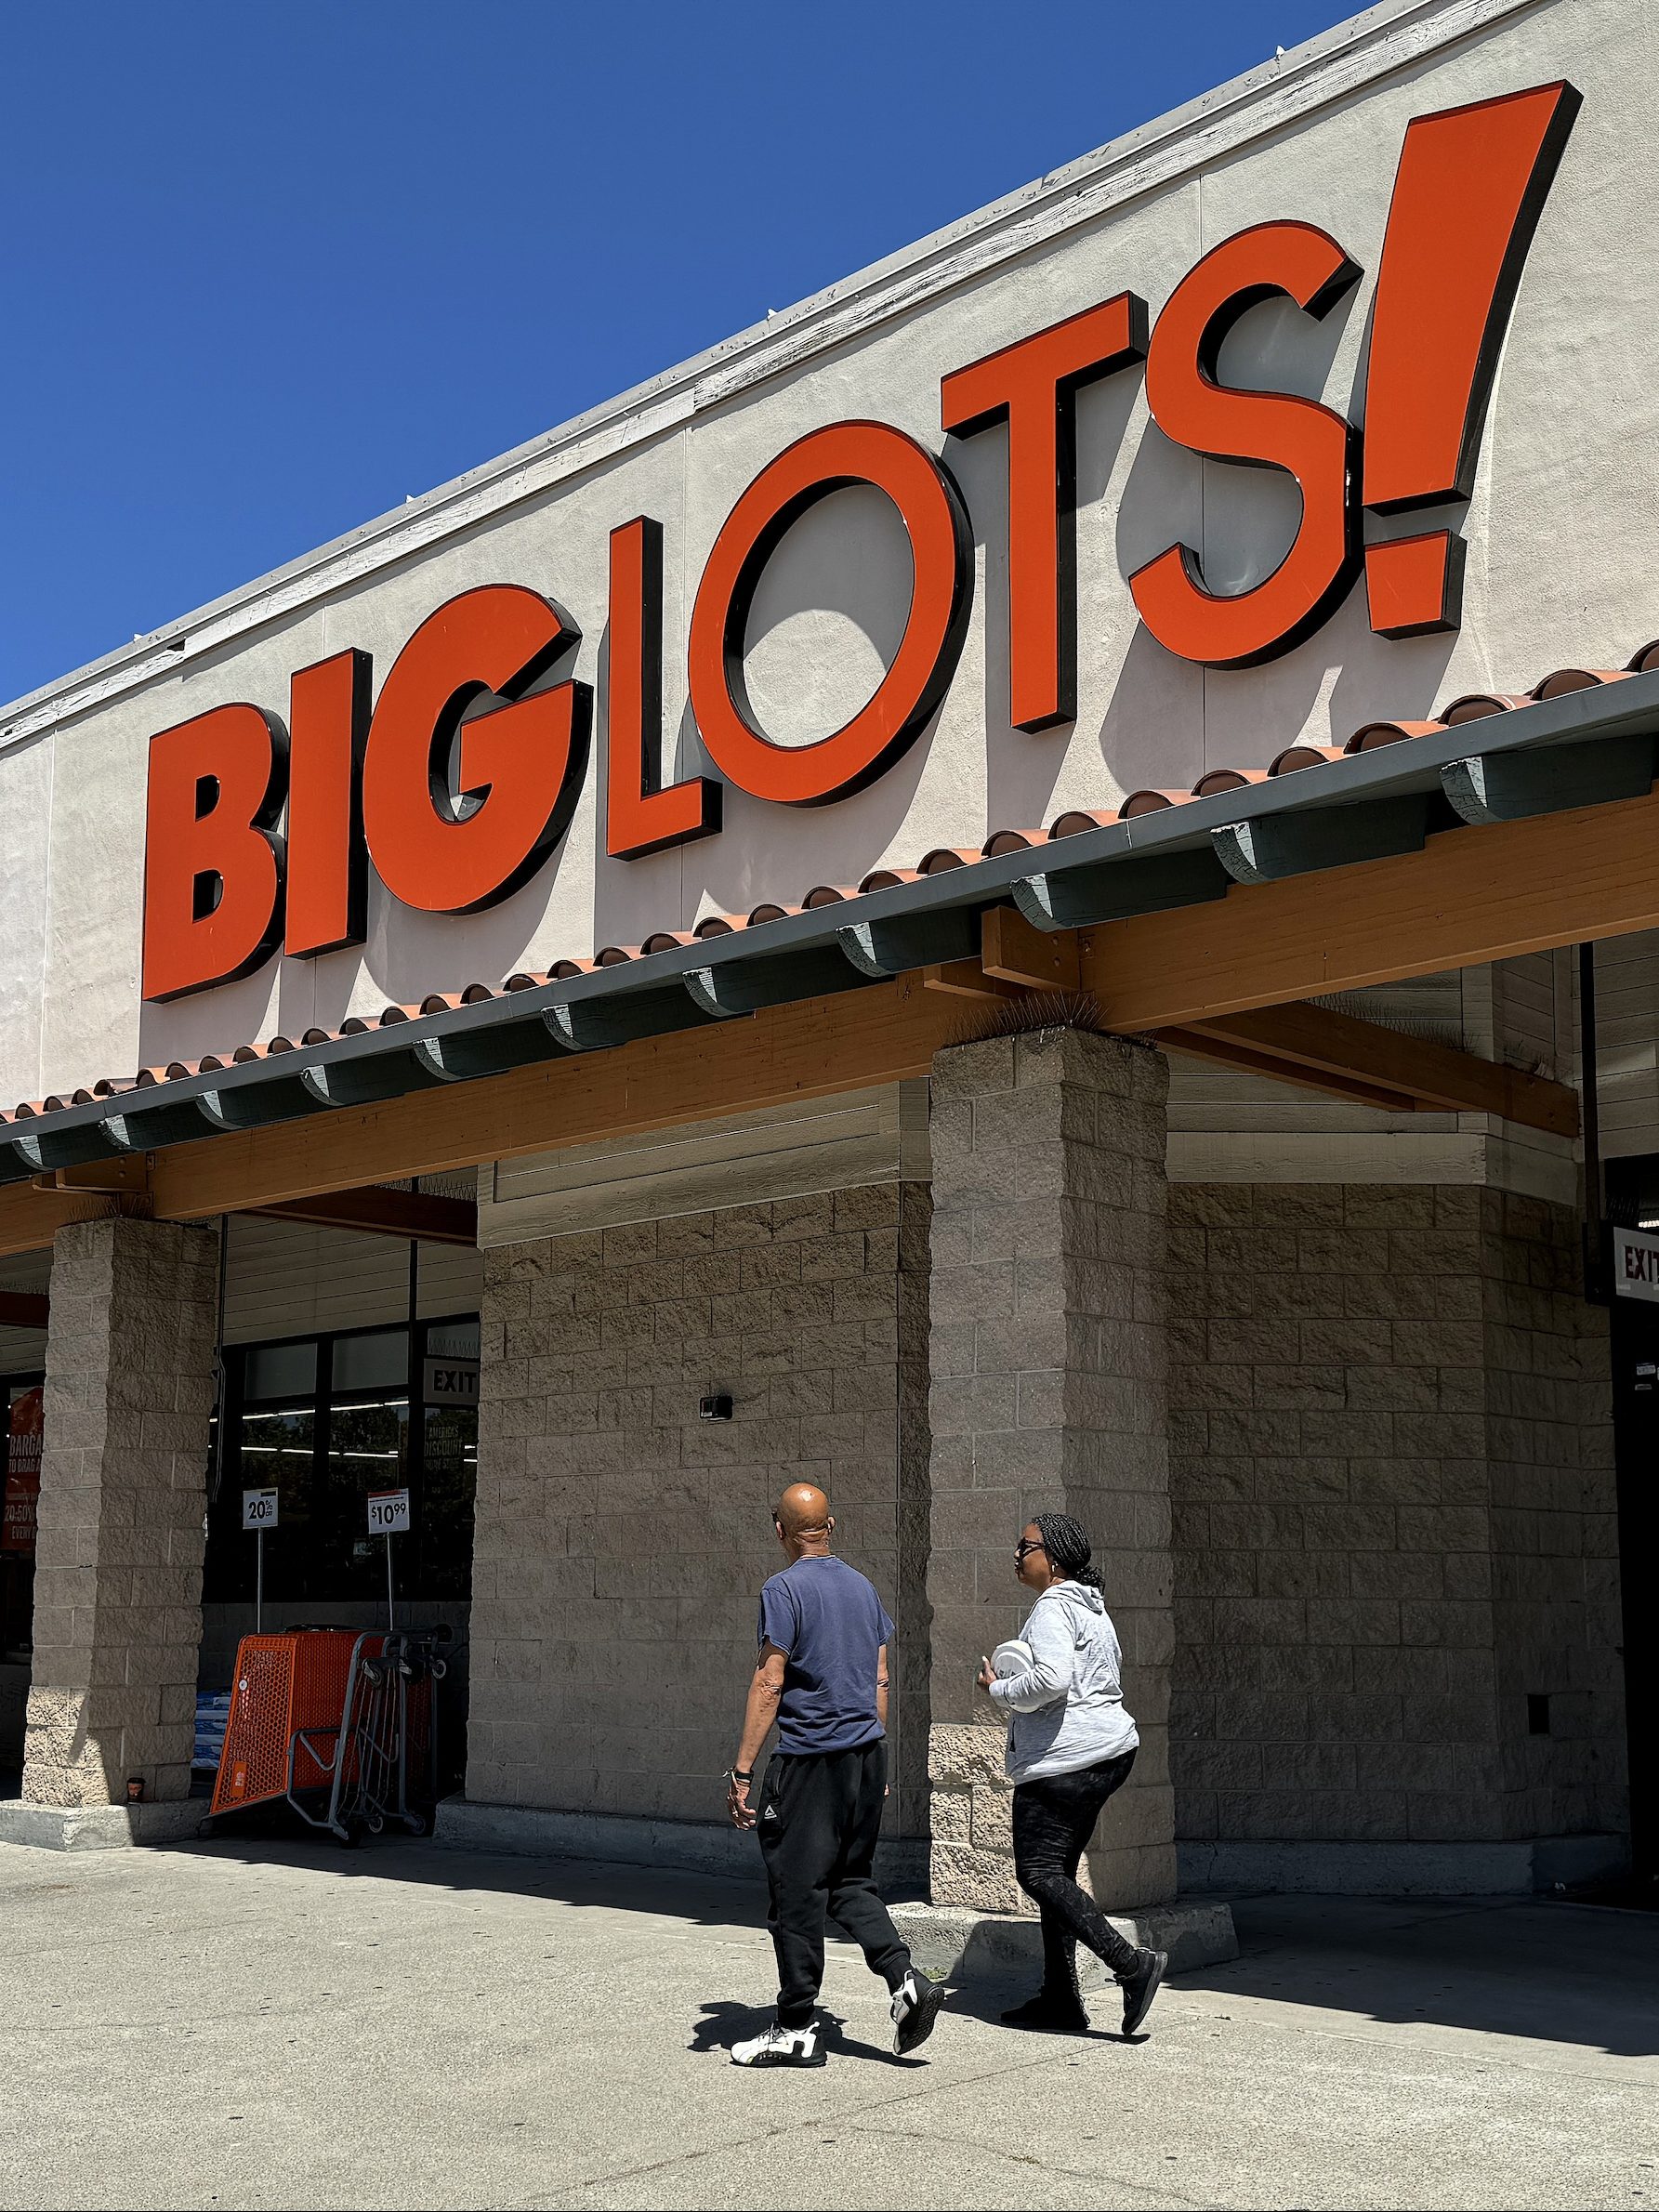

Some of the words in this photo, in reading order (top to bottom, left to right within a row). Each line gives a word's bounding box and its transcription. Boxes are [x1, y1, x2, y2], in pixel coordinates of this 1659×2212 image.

[141, 582, 592, 1004] BIG
[606, 79, 1583, 860] LOTS!
[433, 1369, 477, 1393] EXIT
